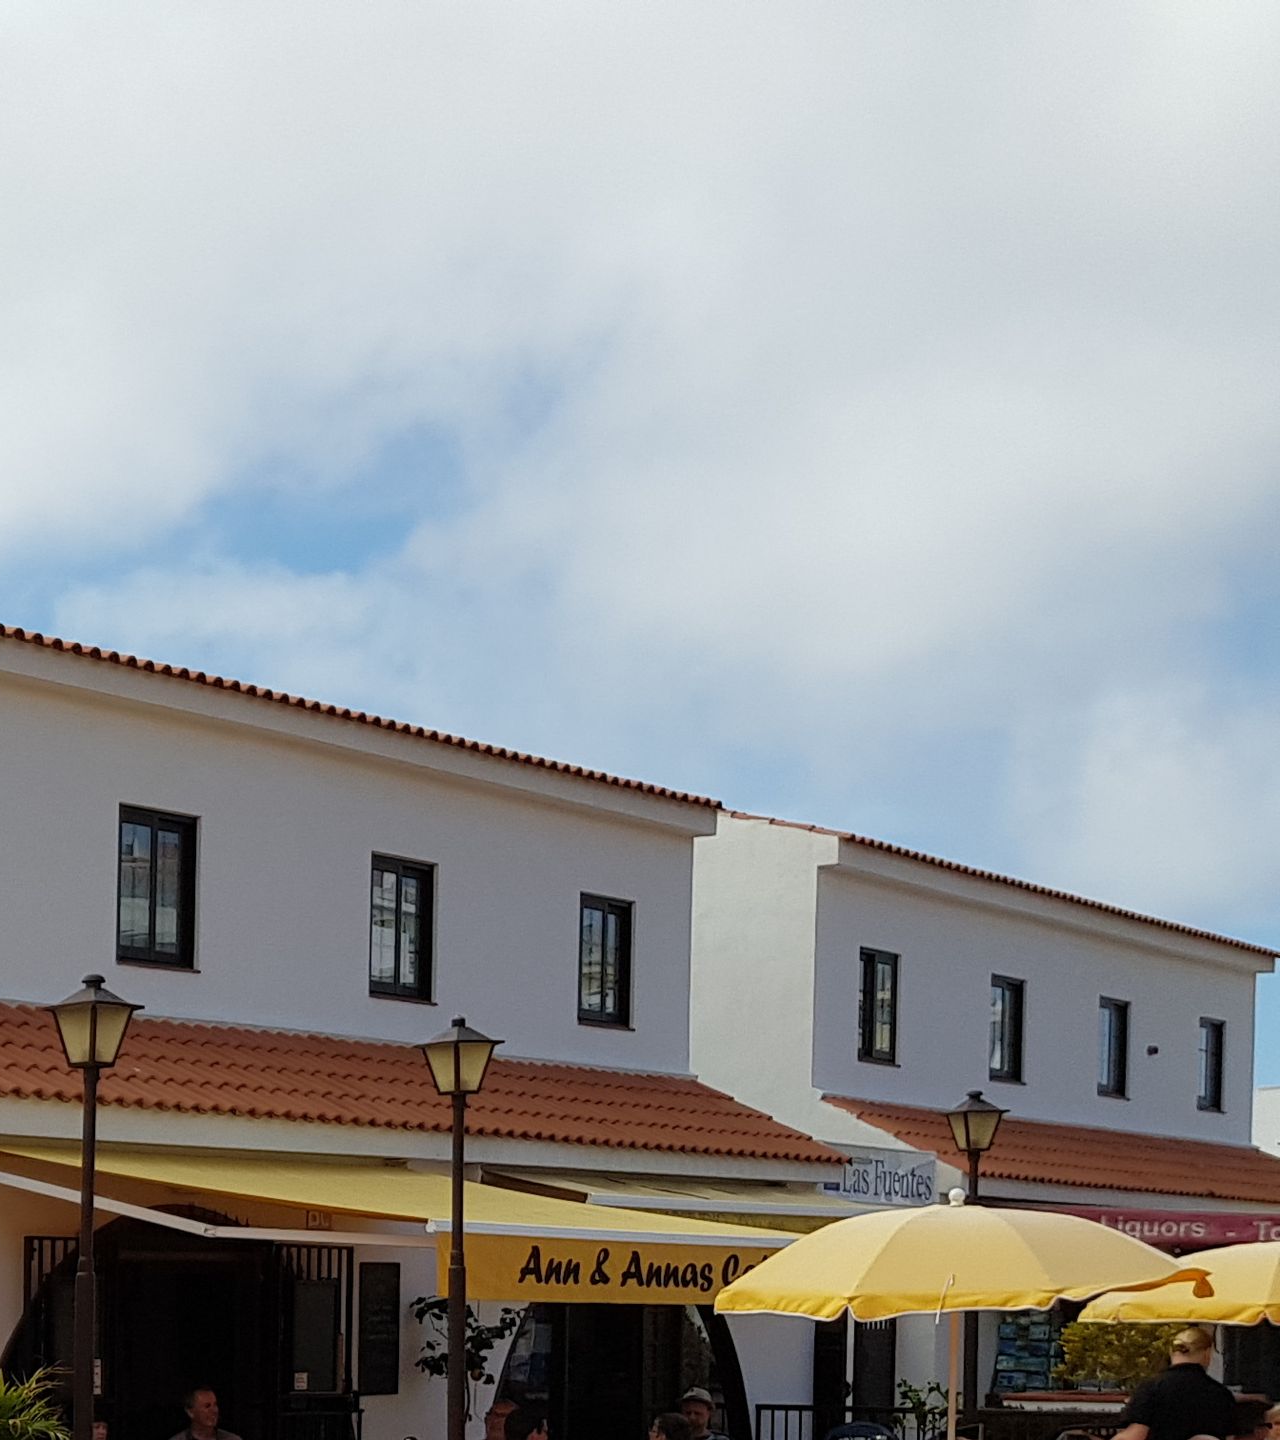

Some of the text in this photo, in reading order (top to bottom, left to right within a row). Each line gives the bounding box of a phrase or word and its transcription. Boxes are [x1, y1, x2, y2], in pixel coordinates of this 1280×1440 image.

[842, 1159, 933, 1200] Las Fuentes
[517, 1245, 581, 1286] Ann
[589, 1247, 611, 1286] &
[619, 1250, 714, 1292] Annas
